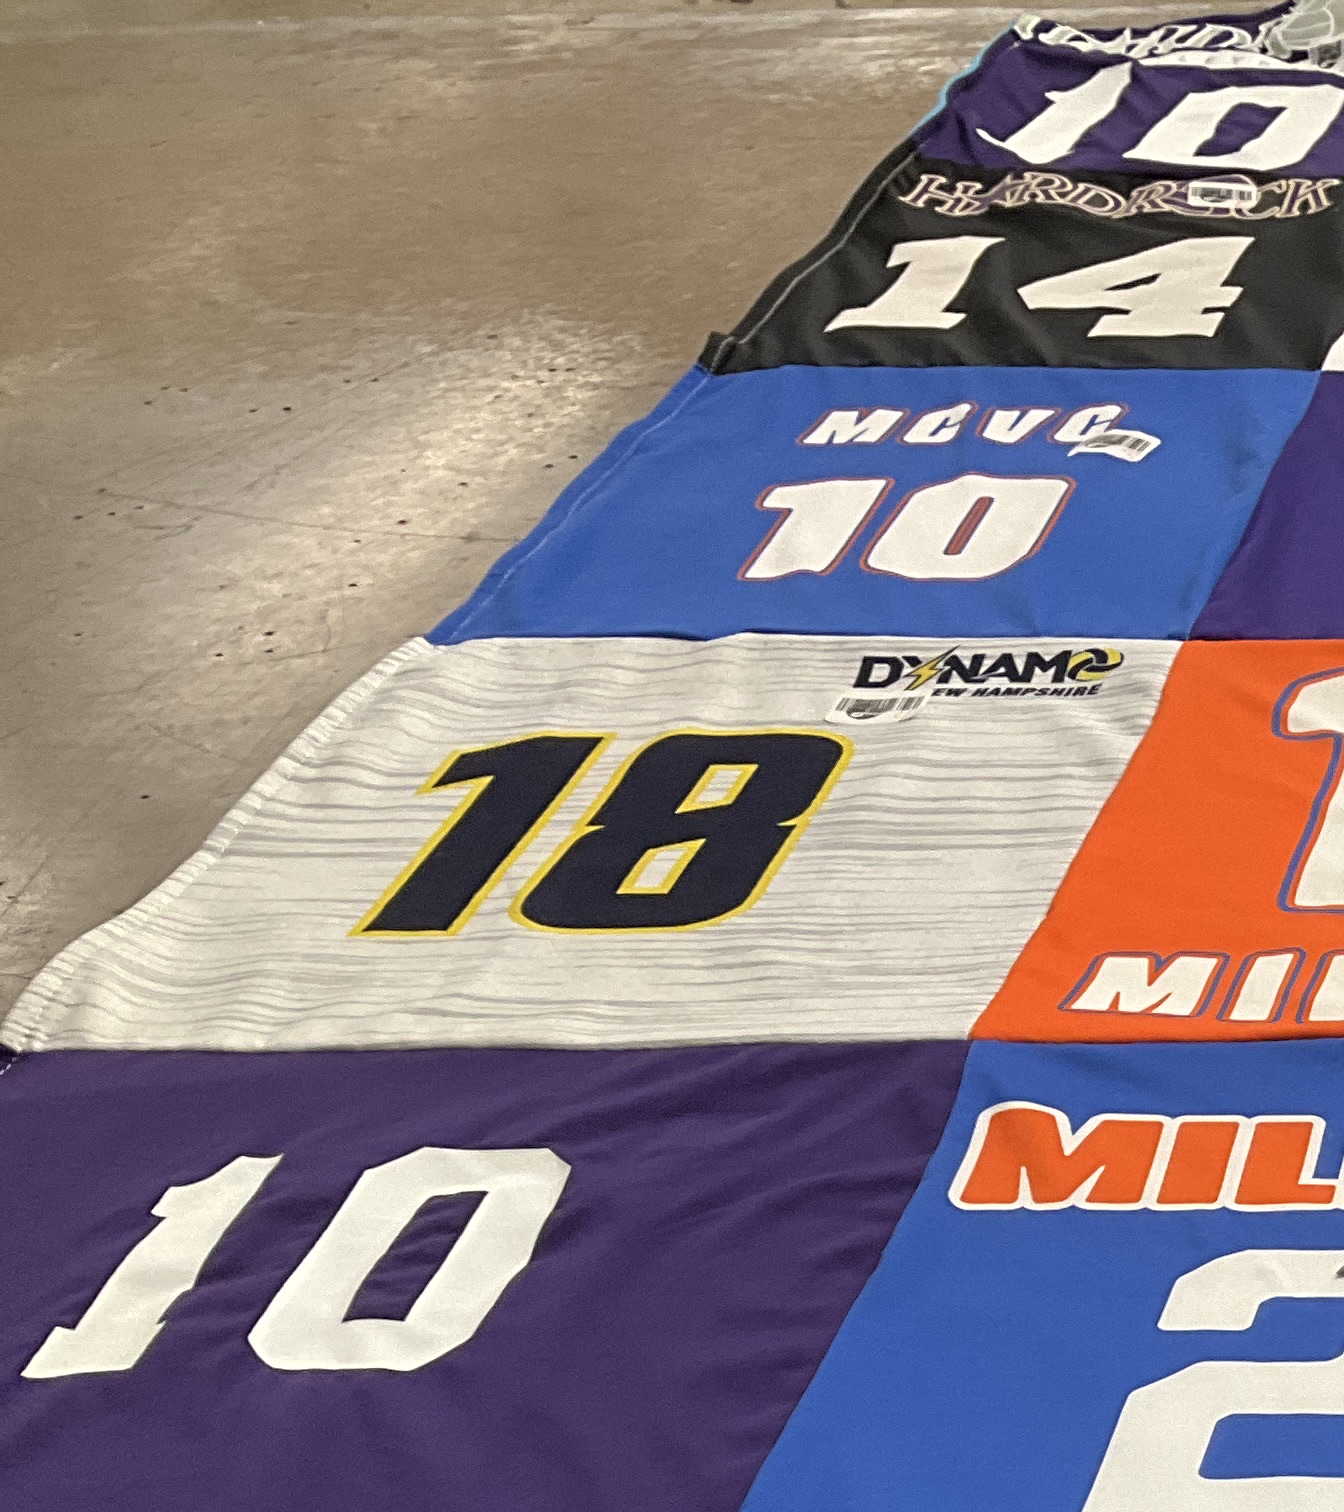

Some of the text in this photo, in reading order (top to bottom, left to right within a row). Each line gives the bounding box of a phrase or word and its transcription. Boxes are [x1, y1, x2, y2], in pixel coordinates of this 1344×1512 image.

[824, 236, 1255, 337] 14
[737, 472, 1078, 581] 10
[928, 683, 1103, 698] EW HAMPSHIRE
[347, 727, 855, 936] 18
[19, 1145, 573, 1379] 10
